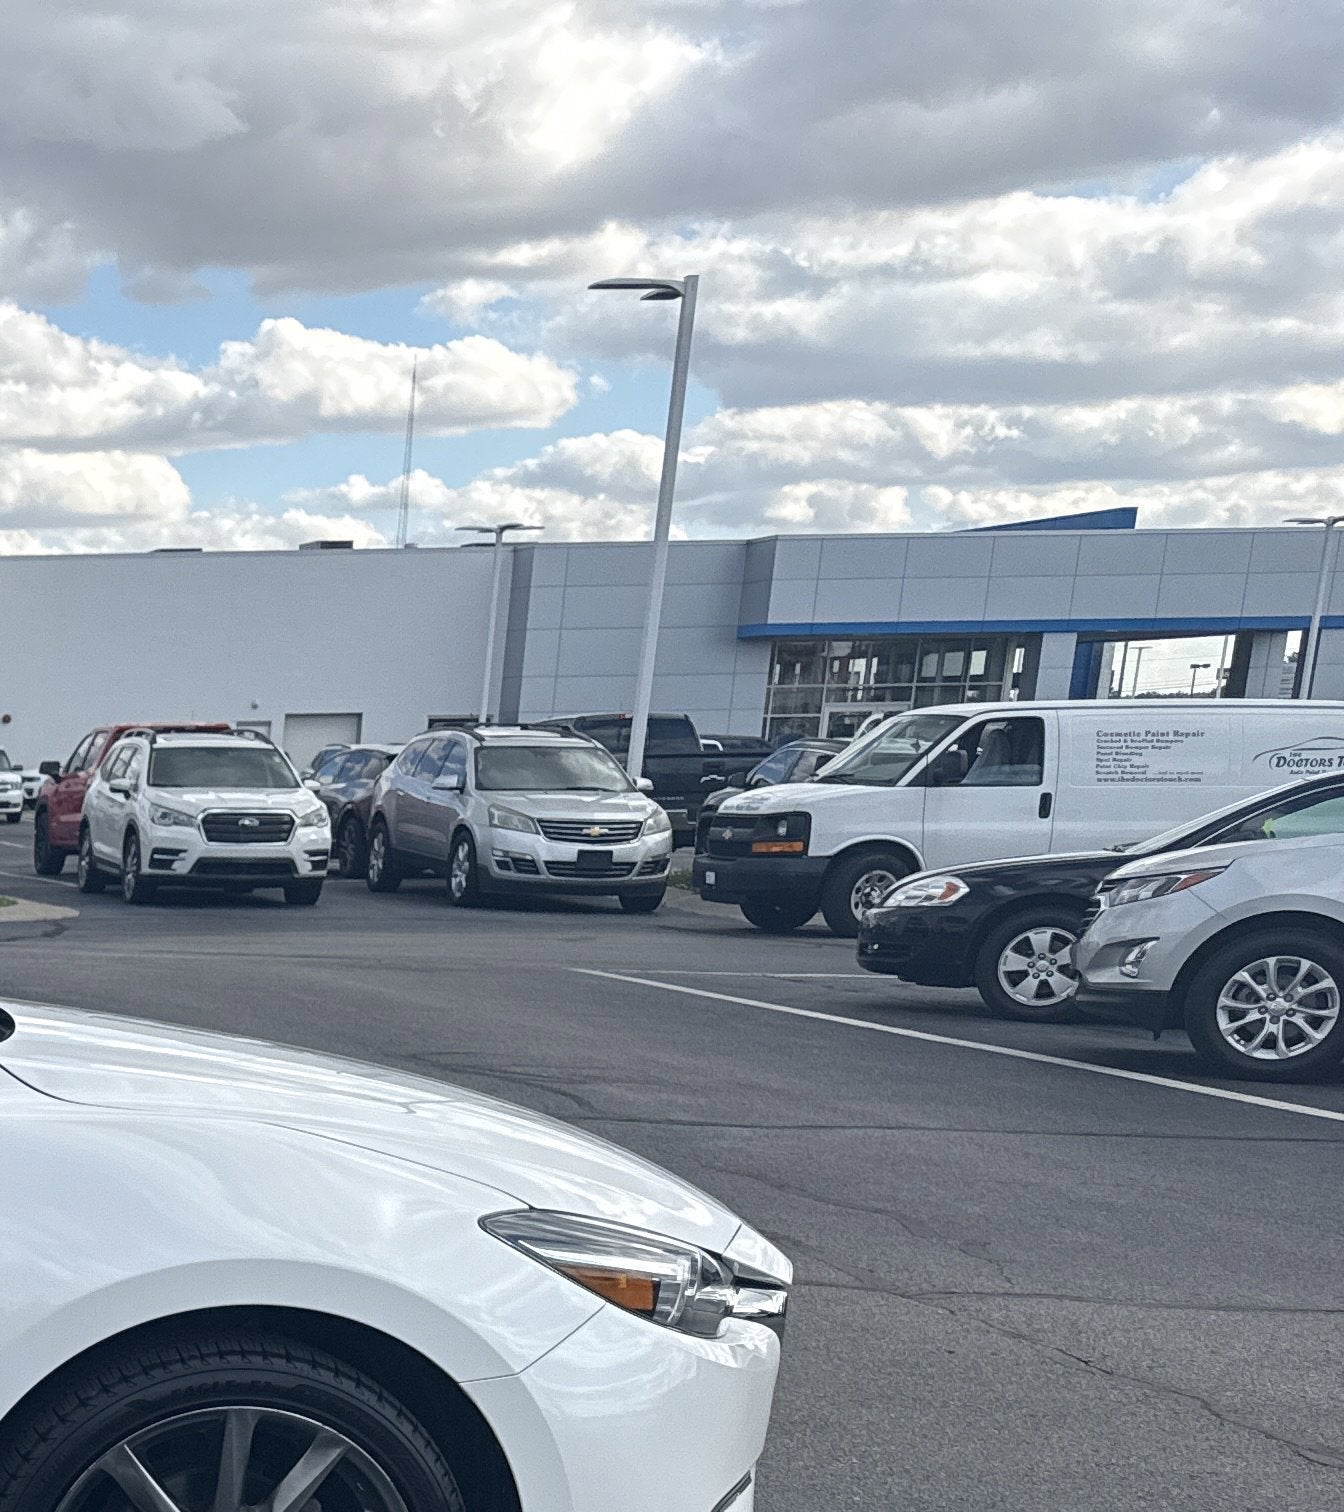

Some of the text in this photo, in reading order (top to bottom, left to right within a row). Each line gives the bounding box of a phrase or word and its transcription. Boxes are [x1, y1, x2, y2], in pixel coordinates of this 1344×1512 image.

[1096, 730, 1206, 739] Cosmetic Paint Repair
